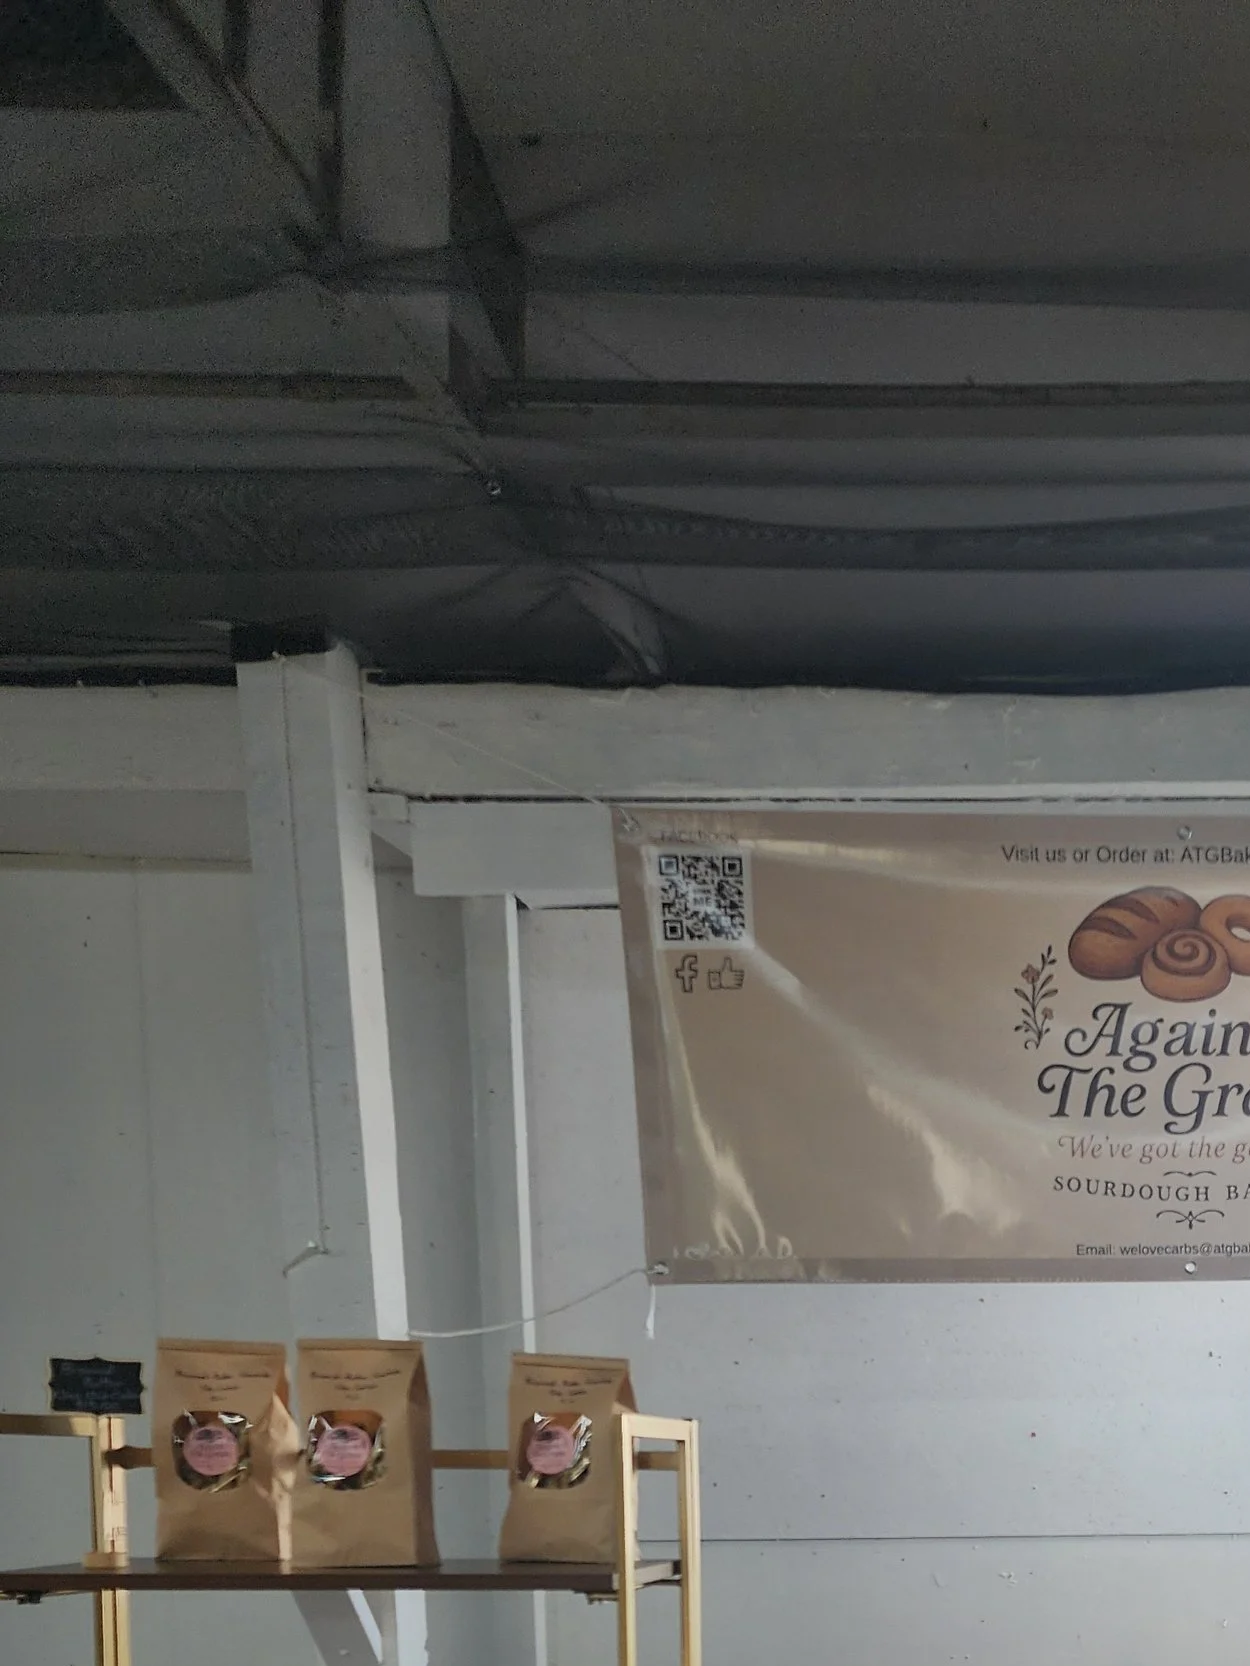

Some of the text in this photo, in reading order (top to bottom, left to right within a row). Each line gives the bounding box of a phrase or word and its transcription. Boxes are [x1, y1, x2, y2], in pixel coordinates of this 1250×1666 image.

[1001, 845, 1039, 863] Visit
[1046, 848, 1066, 863] us
[1073, 848, 1091, 863] or
[1097, 845, 1147, 863] Order
[1154, 846, 1174, 863] at:
[1037, 1064, 1147, 1118] The
[1058, 1135, 1132, 1160] We've
[1139, 1137, 1180, 1164] got
[1188, 1136, 1225, 1159] the
[1053, 1175, 1210, 1202] SOURDOUGH
[1076, 1243, 1116, 1257] Email:
